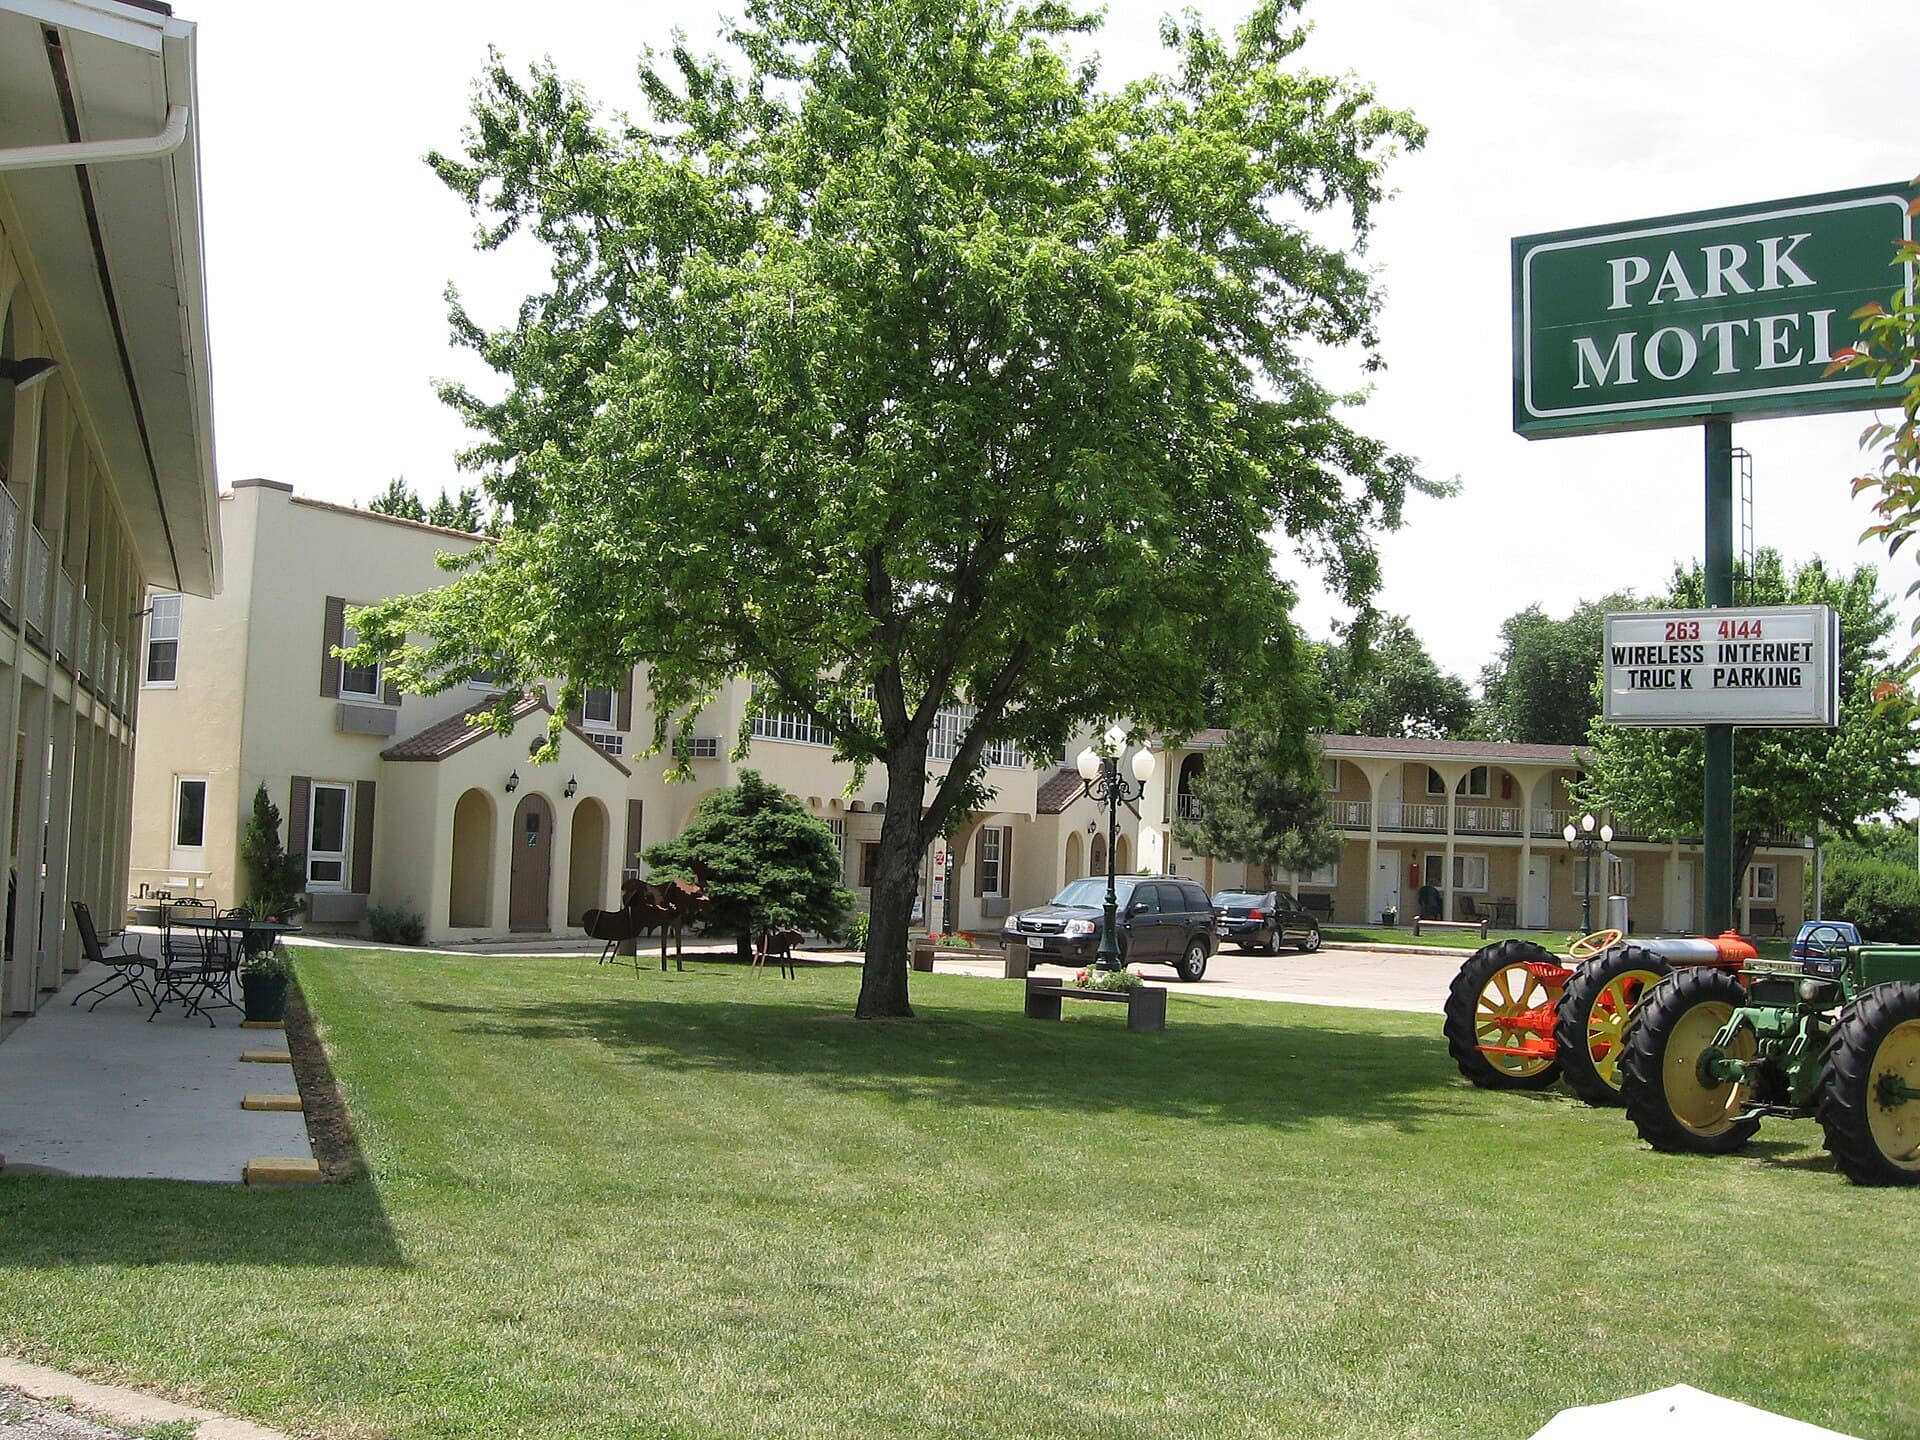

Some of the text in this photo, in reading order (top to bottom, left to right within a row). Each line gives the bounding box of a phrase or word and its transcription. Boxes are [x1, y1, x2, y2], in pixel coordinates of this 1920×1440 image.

[1606, 233, 1816, 311] PARK
[1572, 309, 1857, 390] MOTEL
[1665, 619, 1762, 641] 263 4144
[1611, 642, 1813, 665] WIRELESS INTERNET
[1628, 667, 1801, 689] TRUCK PARKING
